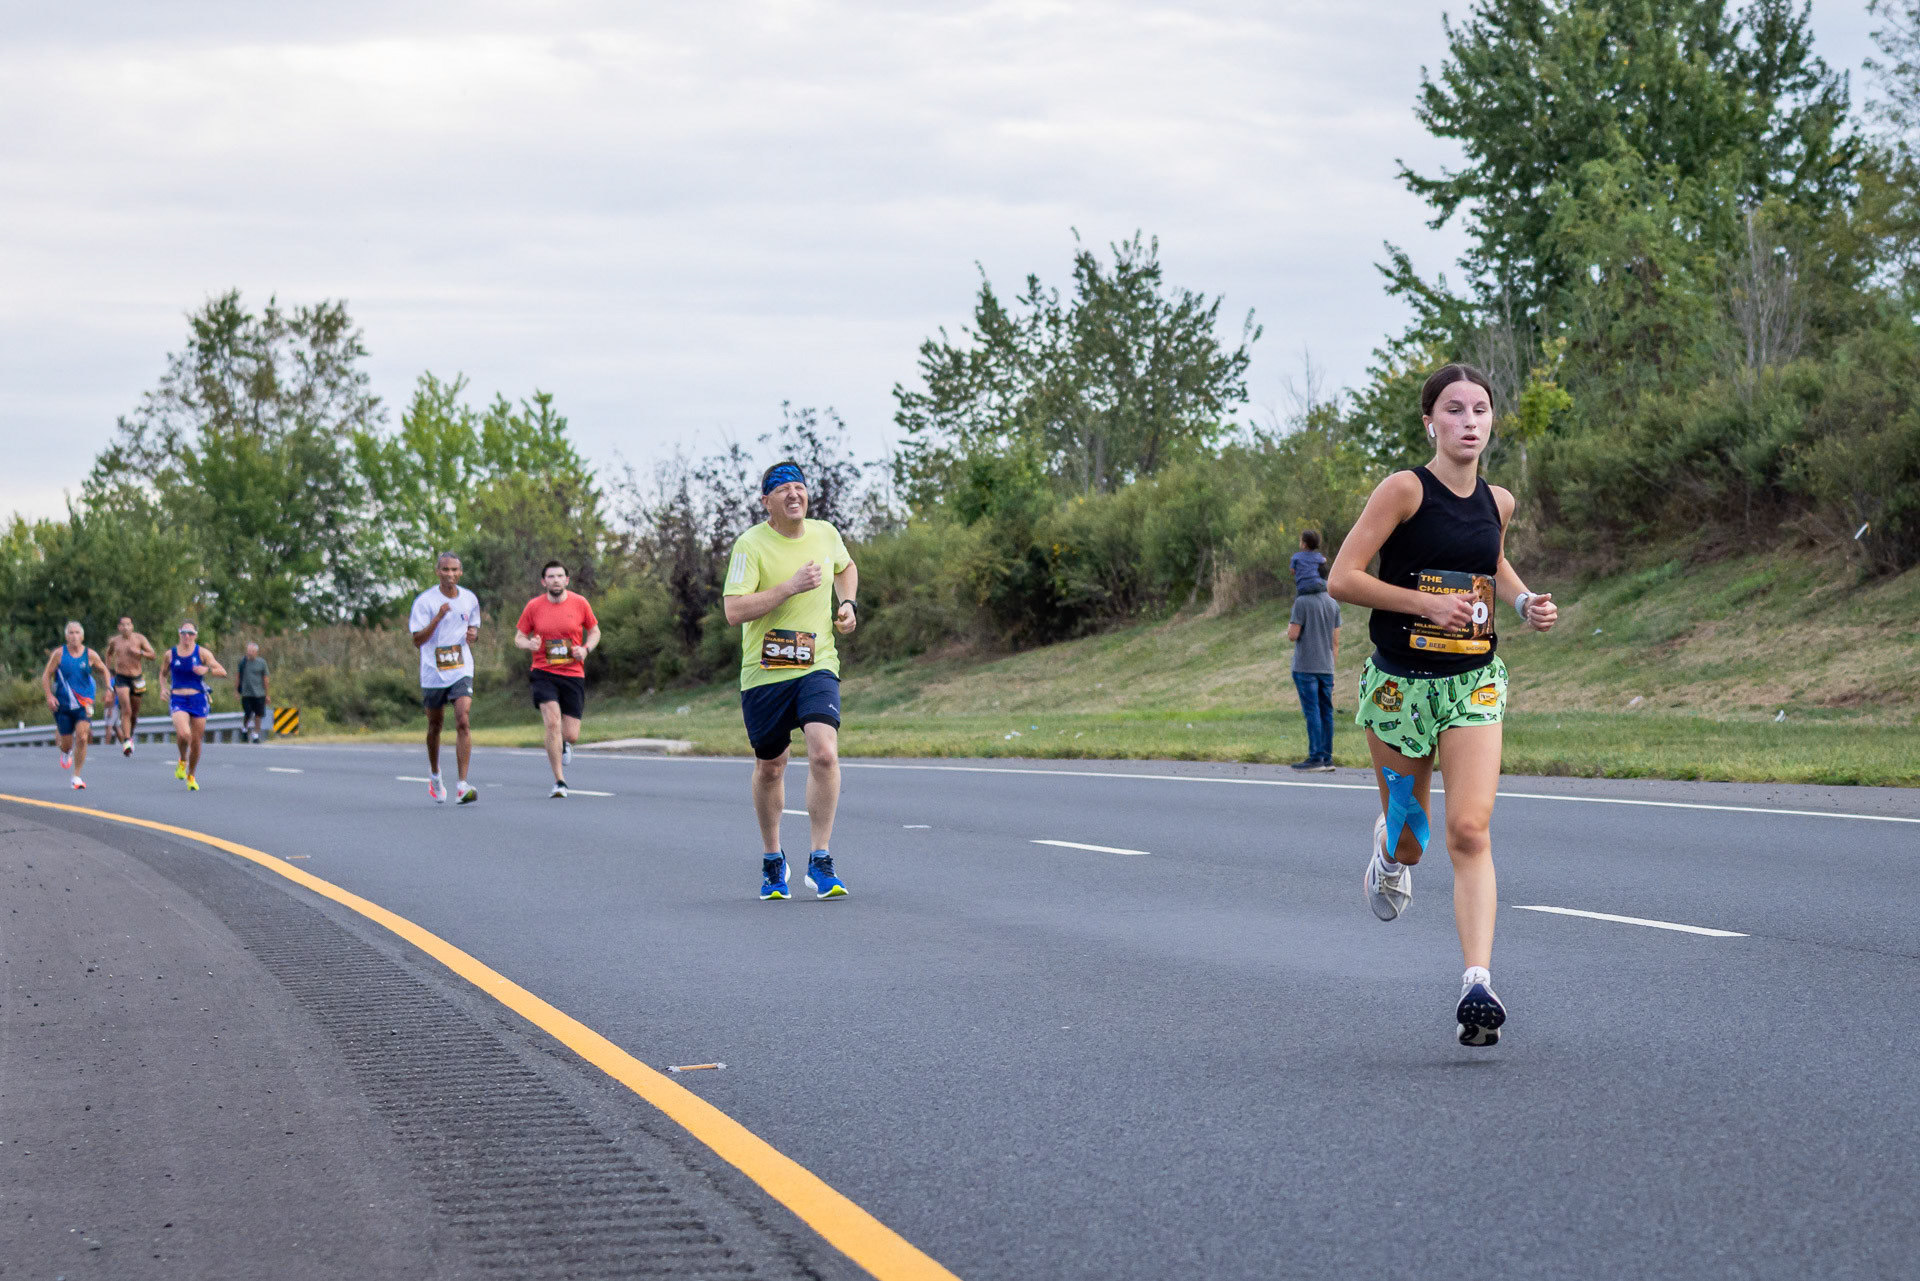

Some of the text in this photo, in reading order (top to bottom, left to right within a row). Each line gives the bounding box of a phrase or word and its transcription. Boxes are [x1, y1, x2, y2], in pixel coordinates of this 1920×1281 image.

[1420, 574, 1442, 584] THE
[1418, 586, 1456, 594] CHASE
[766, 644, 810, 660] 345
